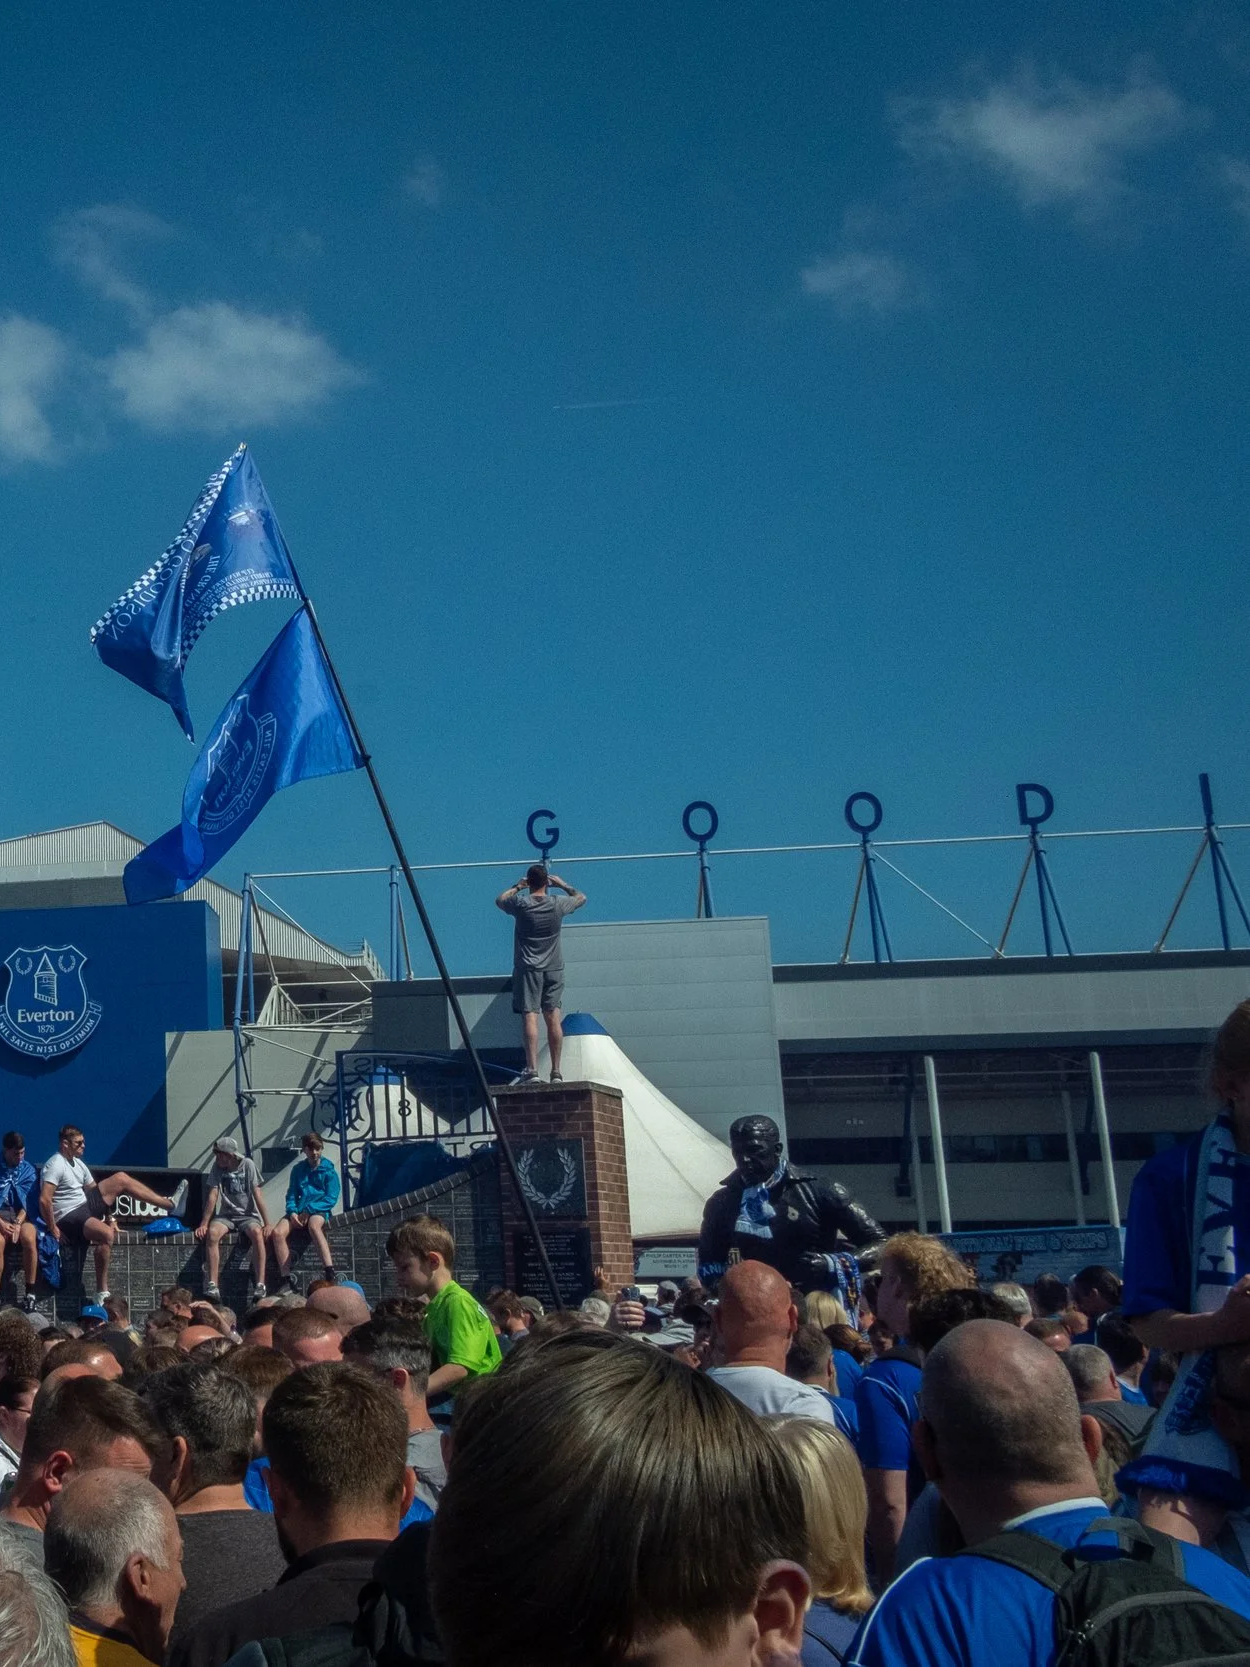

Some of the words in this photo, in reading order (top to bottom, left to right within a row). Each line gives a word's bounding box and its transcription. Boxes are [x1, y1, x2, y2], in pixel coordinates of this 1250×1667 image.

[17, 1008, 75, 1024] Everton
[10, 1034, 34, 1052] SATIS
[36, 1045, 58, 1054] NISI
[60, 1018, 95, 1050] OPTIMUM
[36, 1024, 56, 1034] 1878
[1062, 1231, 1109, 1250] CHIPS
